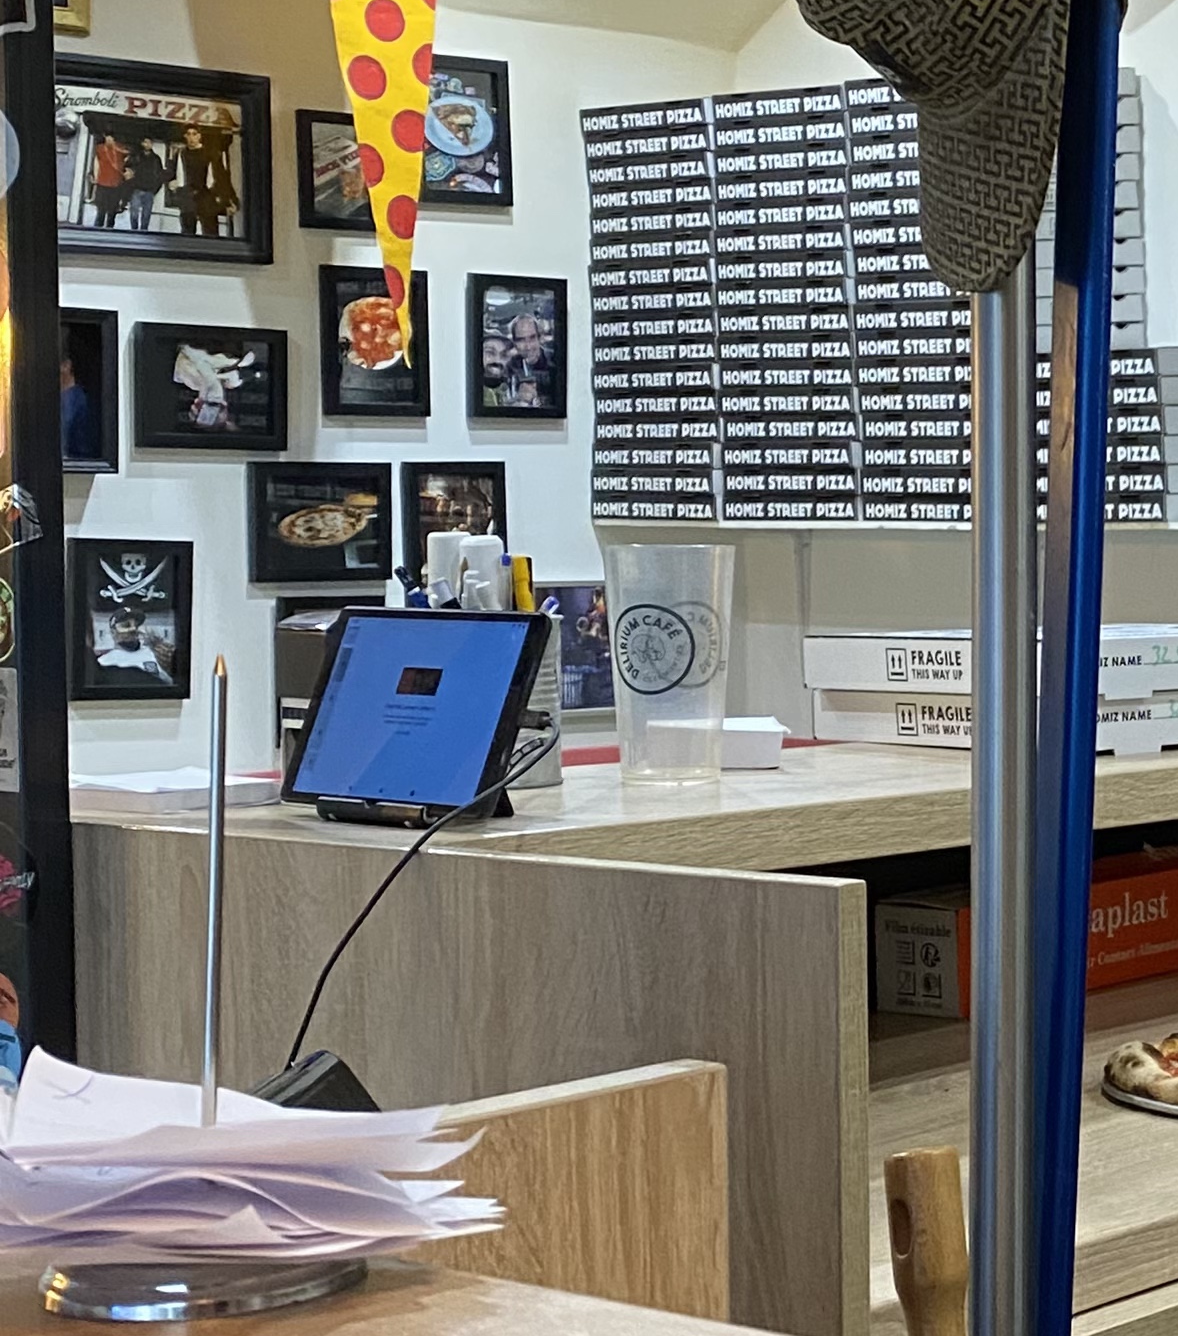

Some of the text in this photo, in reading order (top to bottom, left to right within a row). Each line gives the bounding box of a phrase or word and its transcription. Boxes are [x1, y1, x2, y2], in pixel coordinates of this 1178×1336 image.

[55, 88, 119, 108] Stromboli
[715, 95, 841, 117] HOMIZ STREET PIZZA
[583, 108, 702, 130] HOMIZ STREET PIZZA
[717, 150, 846, 171] HOMIZ STREET PIZZA
[589, 161, 705, 181] HOMIZ STREET PIZZA
[592, 212, 710, 232] HOMIZ STREET PIZZA
[718, 205, 843, 224] HOMIZ STREET PIZZA
[591, 267, 707, 285] HOMIZ STREET PIZZA
[856, 311, 948, 329] HOMIZ STREET
[595, 344, 713, 360] HOMIZ STREET PIZZA
[1111, 359, 1154, 375] PIZZA
[723, 369, 851, 383] HOMIZ STREET PIZZA
[597, 397, 715, 412] HOMIZ STREET PIZZA
[727, 422, 855, 435] HOMIZ STREET PIZZA
[866, 422, 957, 436] HOMIZ STREET
[593, 502, 712, 517] HOMIZ STREET PIZZA
[1119, 504, 1162, 519] PIZZA
[620, 615, 683, 680] DELIRIUM CAFÉ
[911, 650, 961, 666] FRAGILE
[1112, 656, 1142, 666] NAME
[912, 669, 963, 681] THIS WAY UP
[921, 706, 972, 722] FRAGILE
[1097, 710, 1151, 723] OMIZ NAME
[922, 724, 940, 734] THIS
[943, 725, 961, 735] WAY
[1090, 890, 1168, 937] aplast
